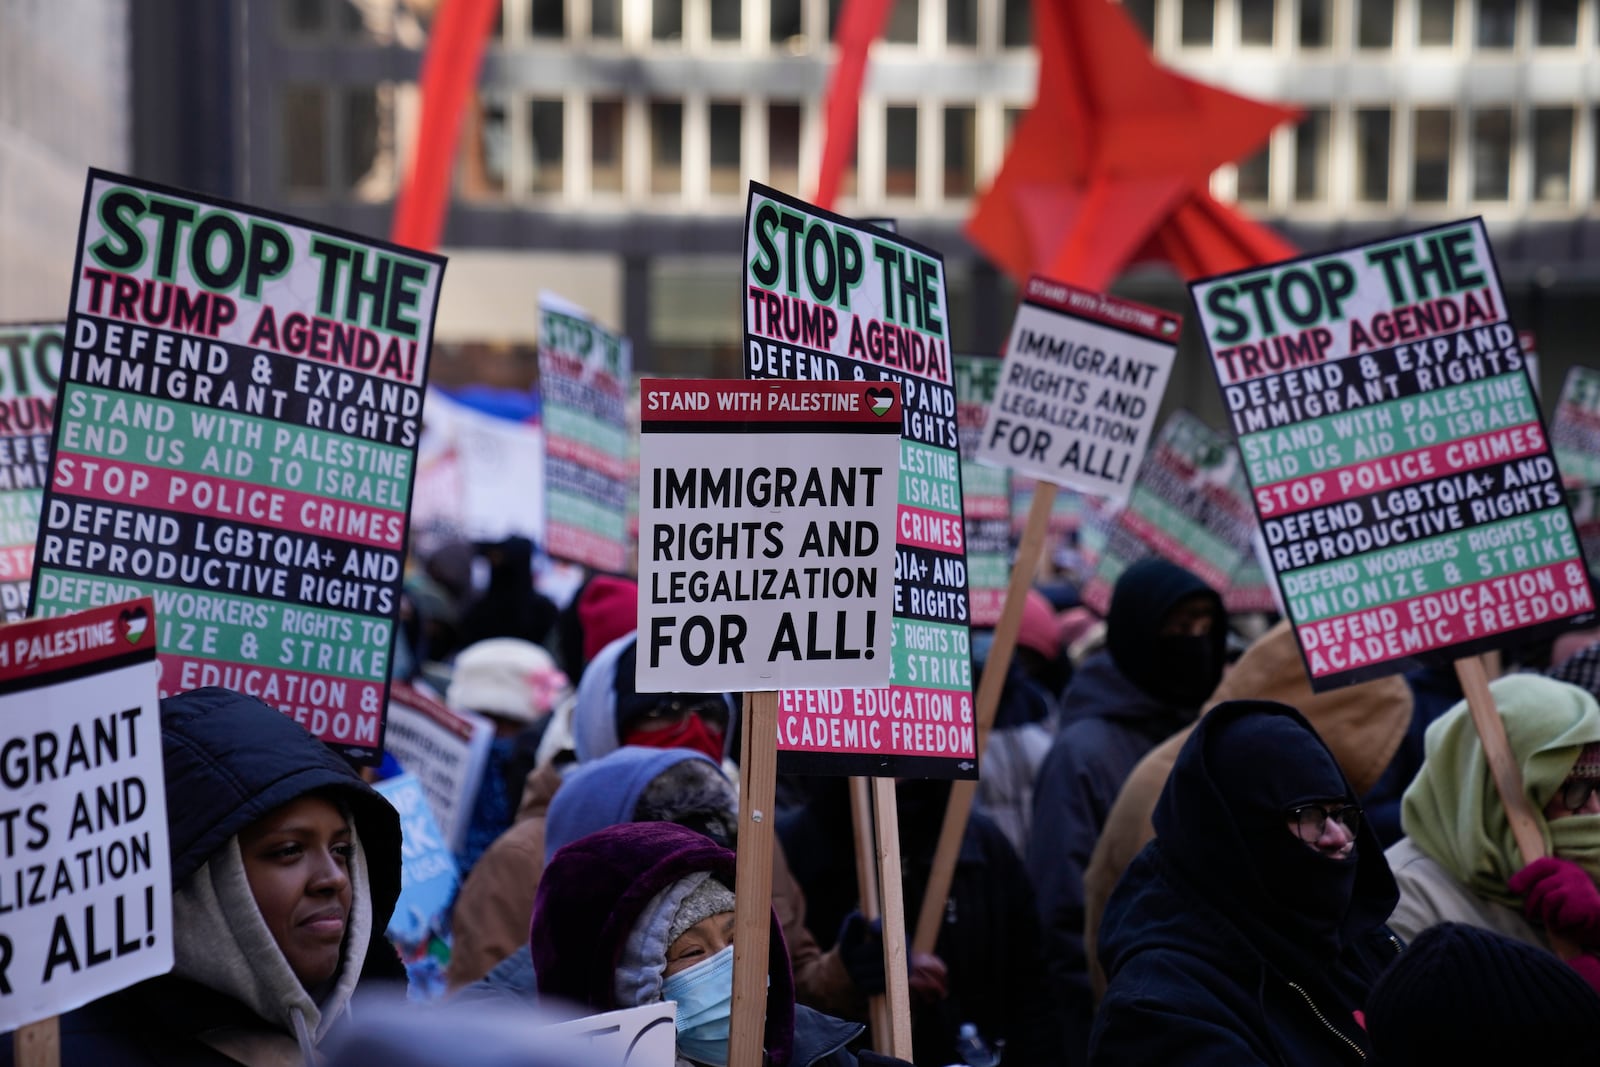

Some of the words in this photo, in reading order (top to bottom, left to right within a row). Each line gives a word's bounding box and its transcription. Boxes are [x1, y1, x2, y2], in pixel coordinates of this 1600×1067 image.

[90, 188, 294, 301] STOP
[308, 234, 430, 340] THE
[750, 200, 864, 311] STOP
[873, 236, 944, 339] THE
[1205, 259, 1357, 346] STOP
[1364, 227, 1488, 306] THE
[83, 267, 237, 337] TRUMP
[248, 306, 418, 381] AGENDA!
[749, 285, 838, 351] TRUMP
[848, 314, 948, 383] AGENDA!
[1015, 328, 1157, 389] IMMIGRANT
[1217, 327, 1332, 384] TRUMP
[1349, 287, 1499, 355] AGENDA!
[0, 331, 65, 395] TO
[74, 319, 229, 374] DEFEND
[252, 355, 272, 385] &
[294, 364, 420, 417] EXPAND
[750, 340, 839, 381] DEFEND
[1008, 362, 1090, 405] RIGHTS
[1095, 388, 1147, 419] AND
[1224, 364, 1343, 411] DEFEND
[1361, 356, 1379, 379] &
[1395, 324, 1514, 371] EXPAND
[1232, 377, 1400, 434] IMMIGRANT
[1416, 348, 1521, 391] RIGHTS
[69, 391, 175, 432] STAND
[191, 411, 263, 449] WITH
[280, 428, 408, 478] PALESTINE
[70, 352, 287, 418] IMMIGRANT
[306, 399, 417, 447] RIGHTS
[647, 391, 710, 411] STAND
[717, 391, 762, 411] WITH
[768, 392, 859, 412] PALESTINE
[903, 409, 957, 448] IGHTS
[1000, 391, 1140, 445] LEGALIZATION
[1245, 426, 1322, 461] STAND
[1333, 408, 1394, 440] WITH
[1402, 380, 1526, 423] PALESTINE
[64, 423, 128, 454] END
[145, 437, 186, 466] US
[202, 449, 253, 477] AID
[269, 458, 301, 487] TO
[316, 467, 402, 508] ISRAEL
[900, 450, 957, 482] LESTINE
[988, 420, 1052, 461] FOR
[1058, 439, 1131, 484] ALL!
[1250, 457, 1299, 484] END
[1311, 448, 1342, 470] US
[1353, 434, 1394, 462] AID
[1409, 423, 1436, 444] TO
[1448, 400, 1533, 435] ISRAEL
[1258, 480, 1326, 514] STOP
[1342, 452, 1435, 494] POLICE
[1446, 426, 1543, 468] CRIMES
[55, 459, 150, 494] STOP
[168, 477, 284, 522] POLICE
[300, 501, 401, 543] CRIMES
[652, 467, 883, 509] IMMIGRANT
[905, 479, 958, 511] ISRAEL
[1264, 503, 1364, 545] DEFEND
[1372, 475, 1493, 518] LGBTQIA+
[1502, 457, 1554, 490] AND
[47, 500, 180, 545] DEFEND
[195, 522, 335, 568] LGBTQIA+
[342, 550, 399, 582] AND
[652, 521, 784, 561] RIGHTS
[798, 520, 879, 558] AND
[901, 511, 962, 548] CRIMES
[1271, 508, 1463, 571] REPRODUCTIVE
[1471, 484, 1561, 525] RIGHTS
[1284, 563, 1359, 597] DEFEND
[1362, 538, 1460, 578] WORKERS'
[1468, 517, 1536, 553] RIGHTS
[1541, 512, 1569, 533] TO
[42, 535, 288, 598] REPRODUCTIVE
[300, 577, 393, 614] RIGHTS
[651, 567, 877, 604] LEGALIZATION
[894, 549, 928, 581] QIA+
[933, 559, 966, 588] AND
[910, 587, 967, 621] RIGHTS
[1289, 573, 1428, 622] UNIONIZE
[1443, 561, 1461, 583] &
[1477, 534, 1578, 575] STRIKE
[153, 588, 276, 628] WORKERS'
[282, 608, 353, 641] RIGHTS
[361, 620, 389, 646] TO
[649, 614, 748, 668] FOR
[767, 610, 876, 662] ALL!
[905, 624, 948, 650] RIGHTS
[951, 631, 968, 655] TO
[1301, 609, 1399, 650] DEFEND
[1408, 569, 1564, 624] EDUCATION
[1566, 561, 1585, 586] &
[1310, 621, 1453, 676] ACADEMIC
[1464, 586, 1592, 636] FREEDOM
[15, 620, 115, 665] PALESTINE
[240, 630, 259, 659] &
[280, 639, 384, 678] STRIKE
[908, 654, 971, 686] STRIKE
[180, 662, 347, 708] EDUCATION
[360, 686, 379, 713] &
[778, 688, 843, 715] EFEND
[853, 688, 953, 722] EDUCATION
[960, 697, 972, 723] &
[0, 706, 142, 790] GRANT
[278, 704, 377, 743] EDOM
[891, 722, 974, 754] FREEDOM
[68, 776, 147, 840] AND
[0, 832, 151, 914] LIZATION
[42, 884, 156, 984] ALL!
